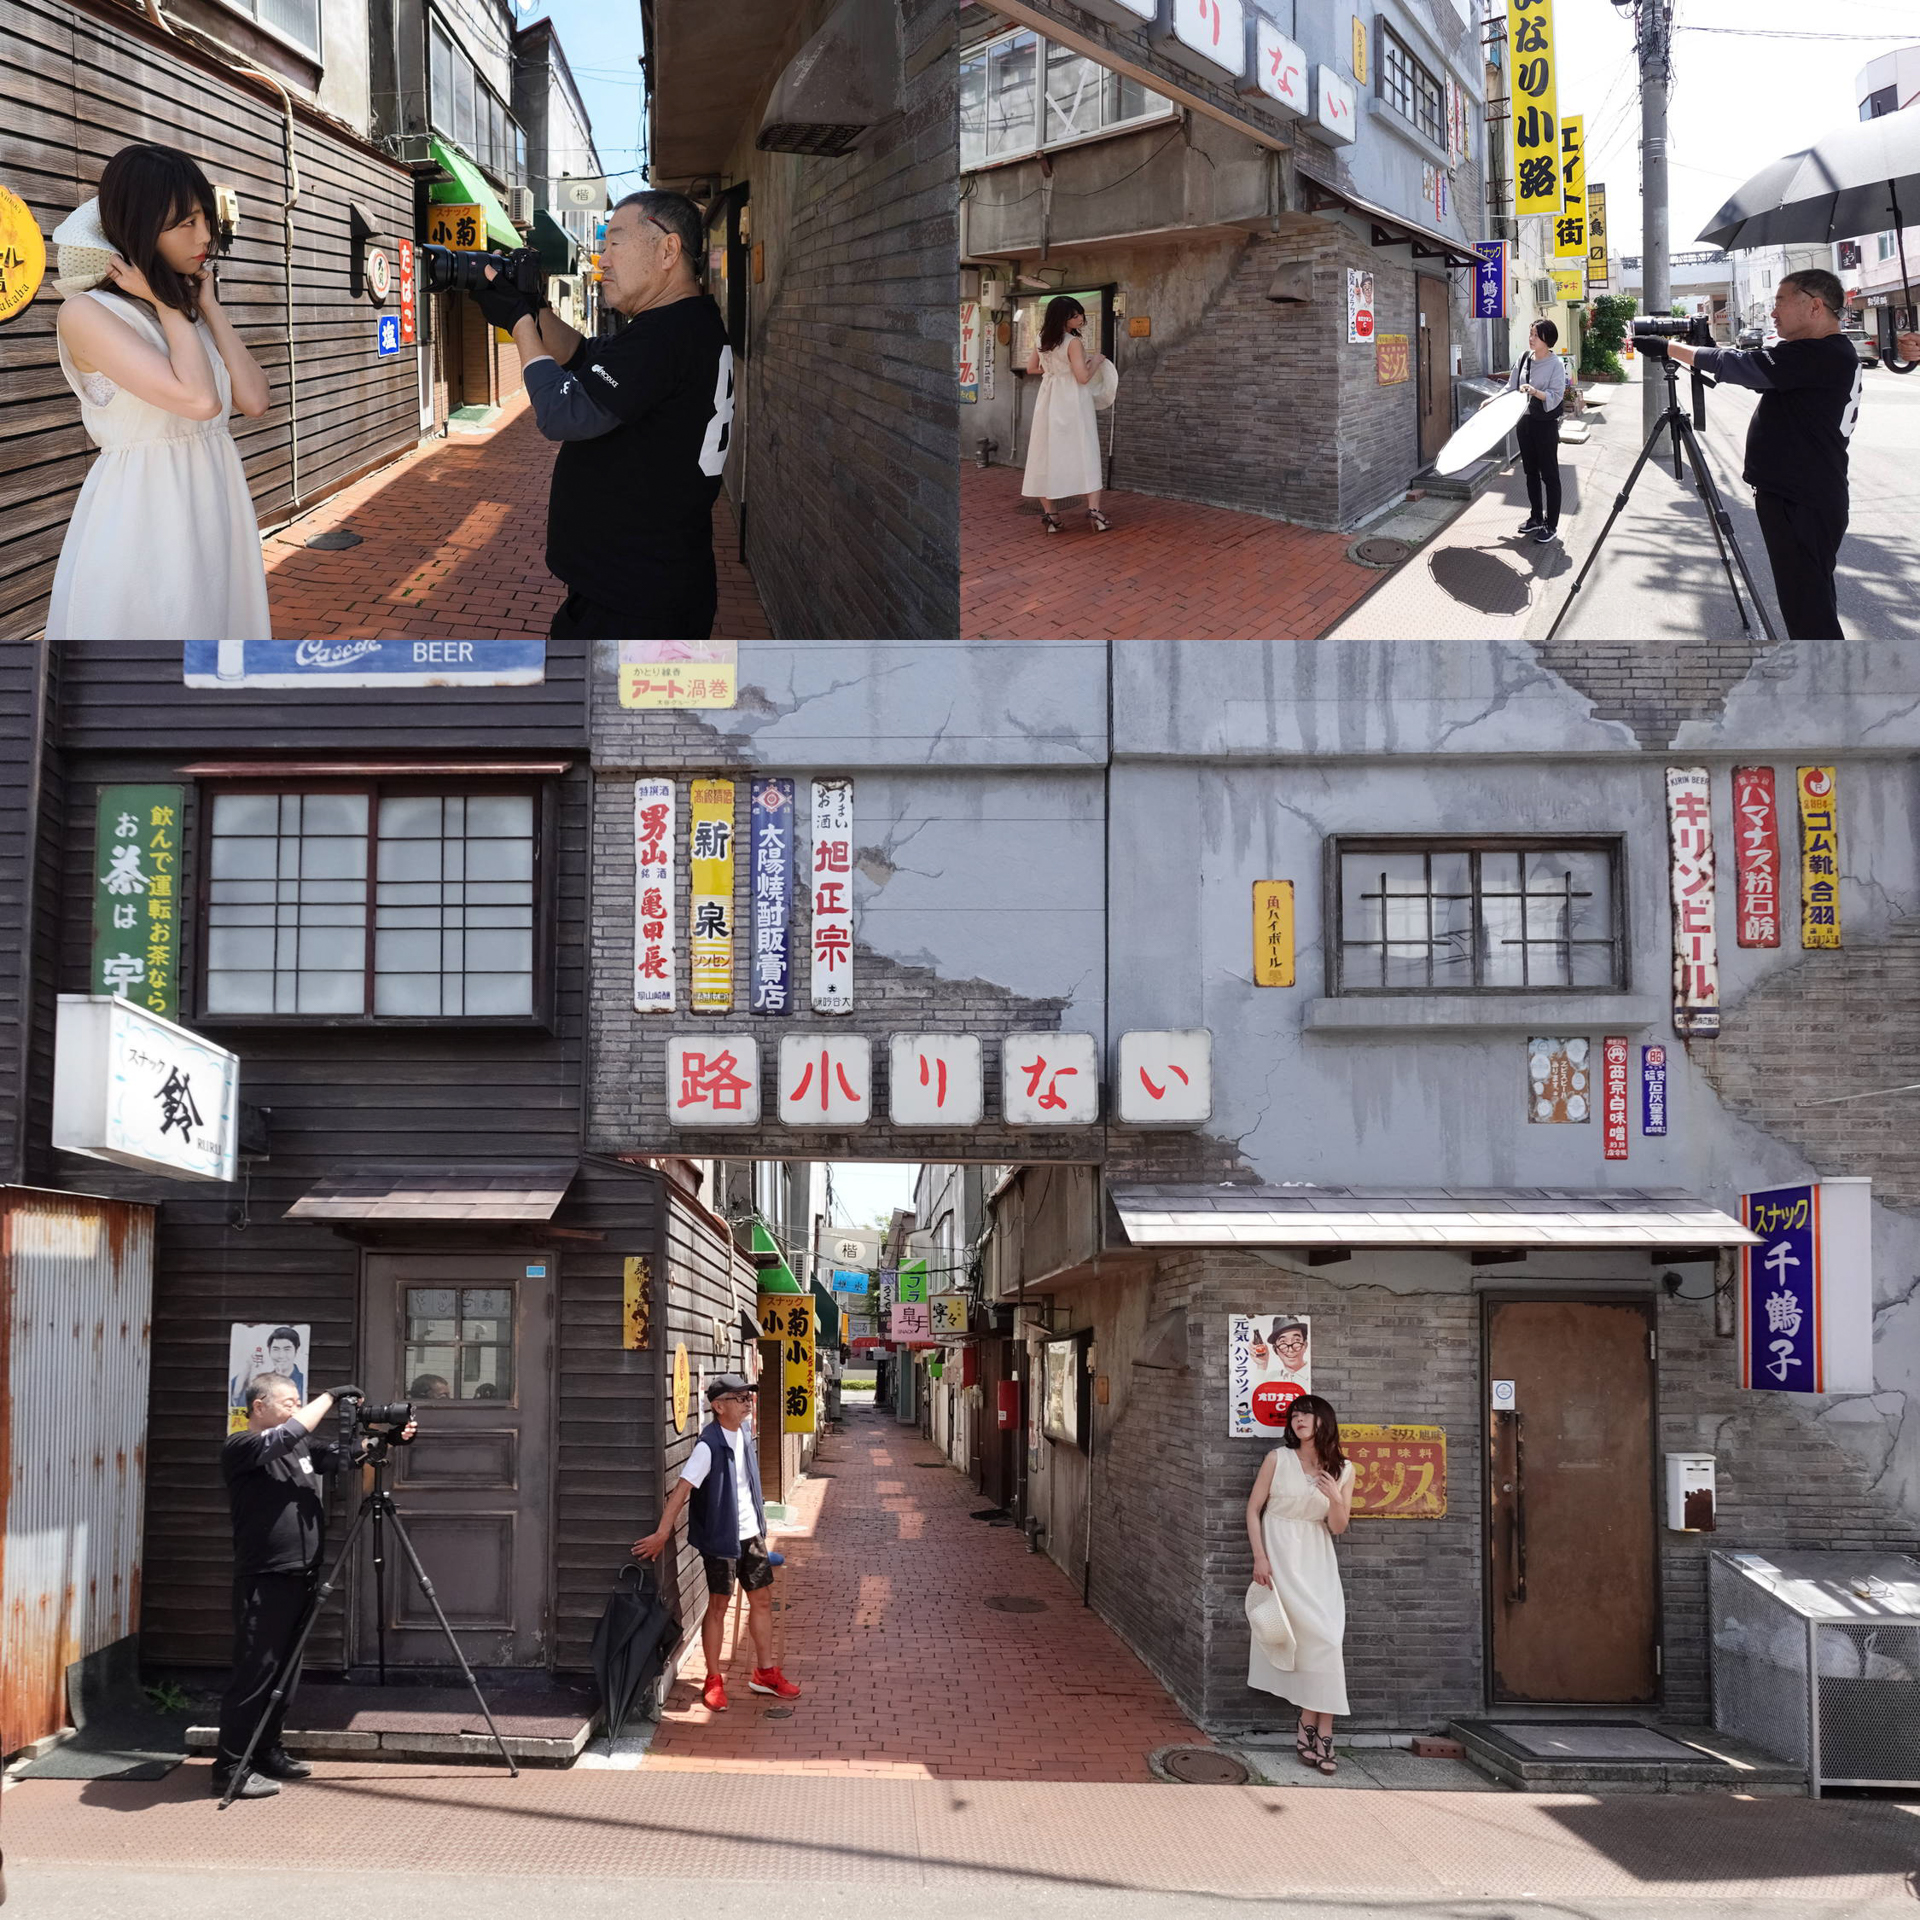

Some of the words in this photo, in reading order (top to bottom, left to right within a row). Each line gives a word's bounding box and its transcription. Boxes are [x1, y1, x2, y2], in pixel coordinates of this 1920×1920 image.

[1514, 0, 1557, 200] なり小路
[436, 206, 471, 217] スナック
[432, 216, 477, 247] 小菊
[401, 244, 413, 333] たばこ
[382, 320, 398, 350] 塩
[413, 641, 474, 662] BEER
[637, 803, 670, 867] 男山
[814, 839, 851, 973] 旭正宗
[1675, 791, 1715, 999] キリンビール
[692, 952, 731, 968] シンセン
[1755, 1198, 1808, 1234] スナック
[767, 1297, 804, 1307] スナック
[1764, 1240, 1803, 1382] 千鶴子
[762, 1307, 810, 1338] 小菊
[1234, 1317, 1249, 1343] 元気
[786, 1340, 808, 1417] 小菊
